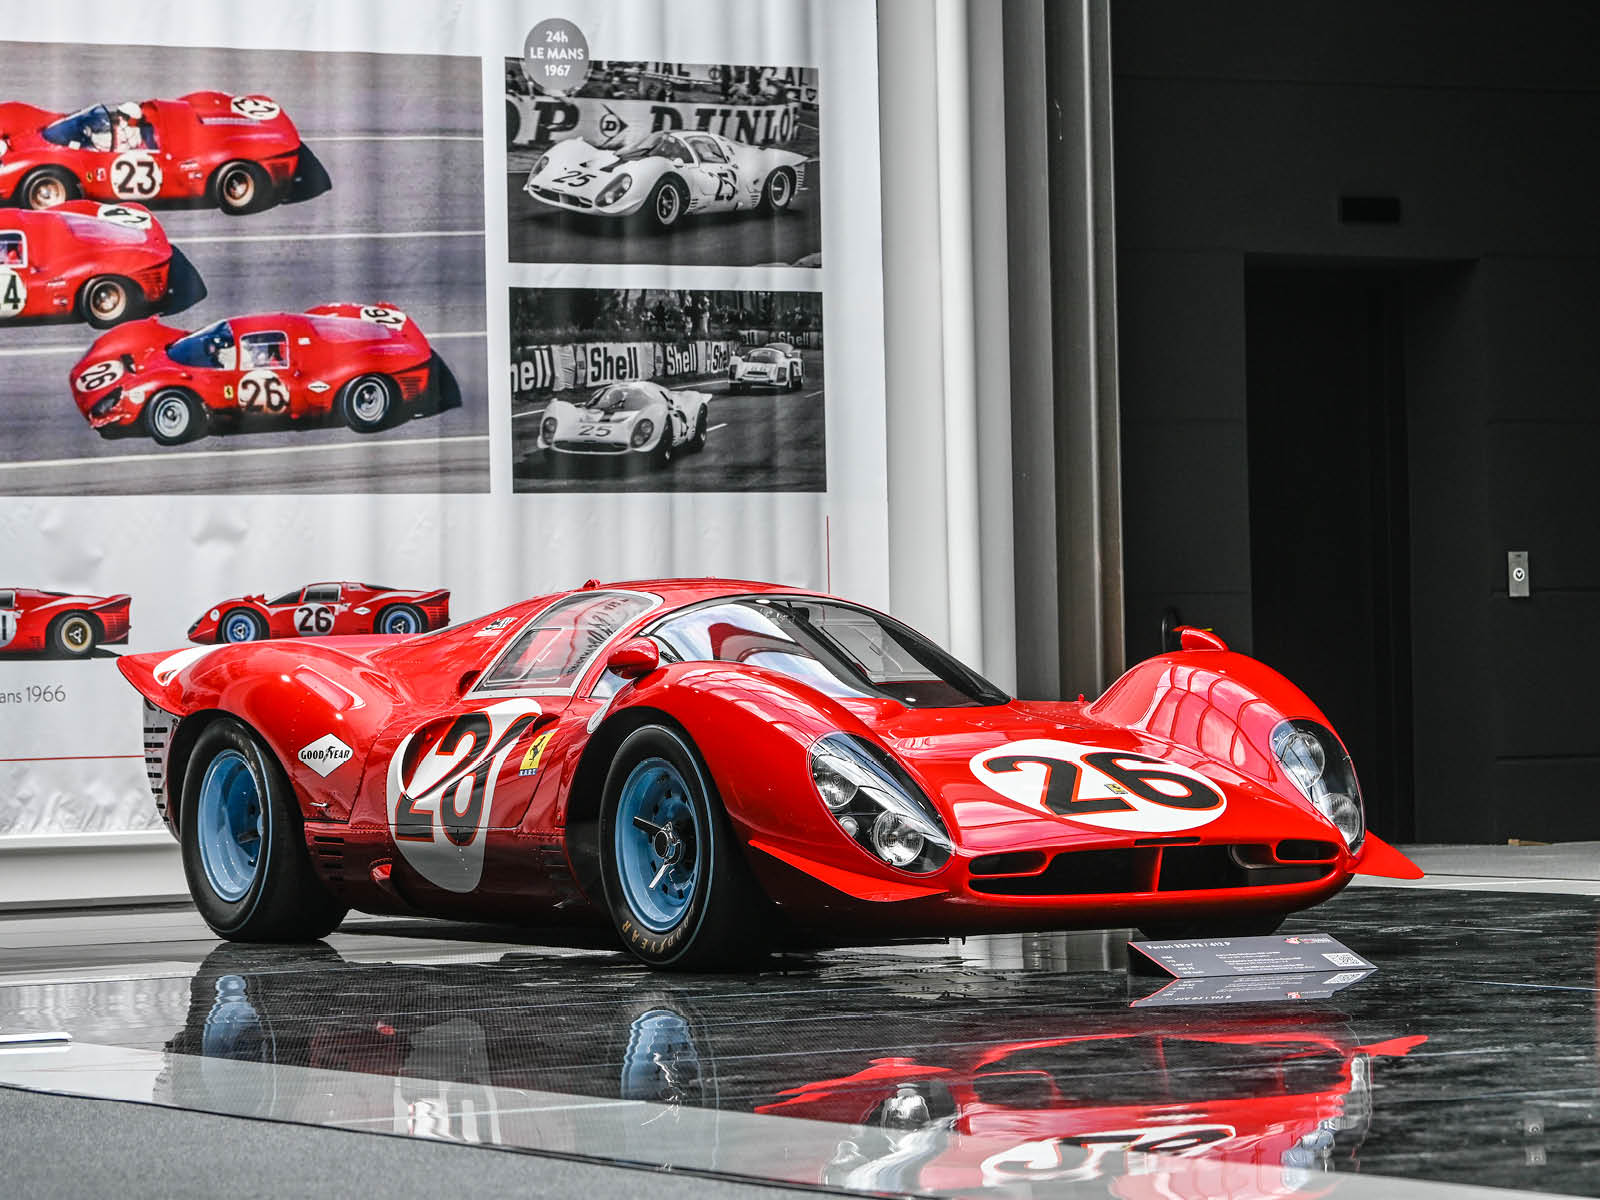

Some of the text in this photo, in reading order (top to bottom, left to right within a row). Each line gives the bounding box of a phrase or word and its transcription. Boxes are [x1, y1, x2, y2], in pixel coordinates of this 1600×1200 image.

[545, 30, 569, 43] 24h
[530, 47, 584, 60] LE MANS
[544, 64, 571, 77] 1967
[115, 160, 157, 195] 23
[551, 170, 598, 188] 25
[590, 346, 640, 382] Shell
[666, 343, 698, 376] Shell
[80, 362, 118, 391] 26
[241, 377, 290, 412] 26
[578, 424, 613, 437] 25
[298, 606, 333, 633] 26
[26, 684, 66, 703] 1966
[982, 751, 1224, 817] 26
